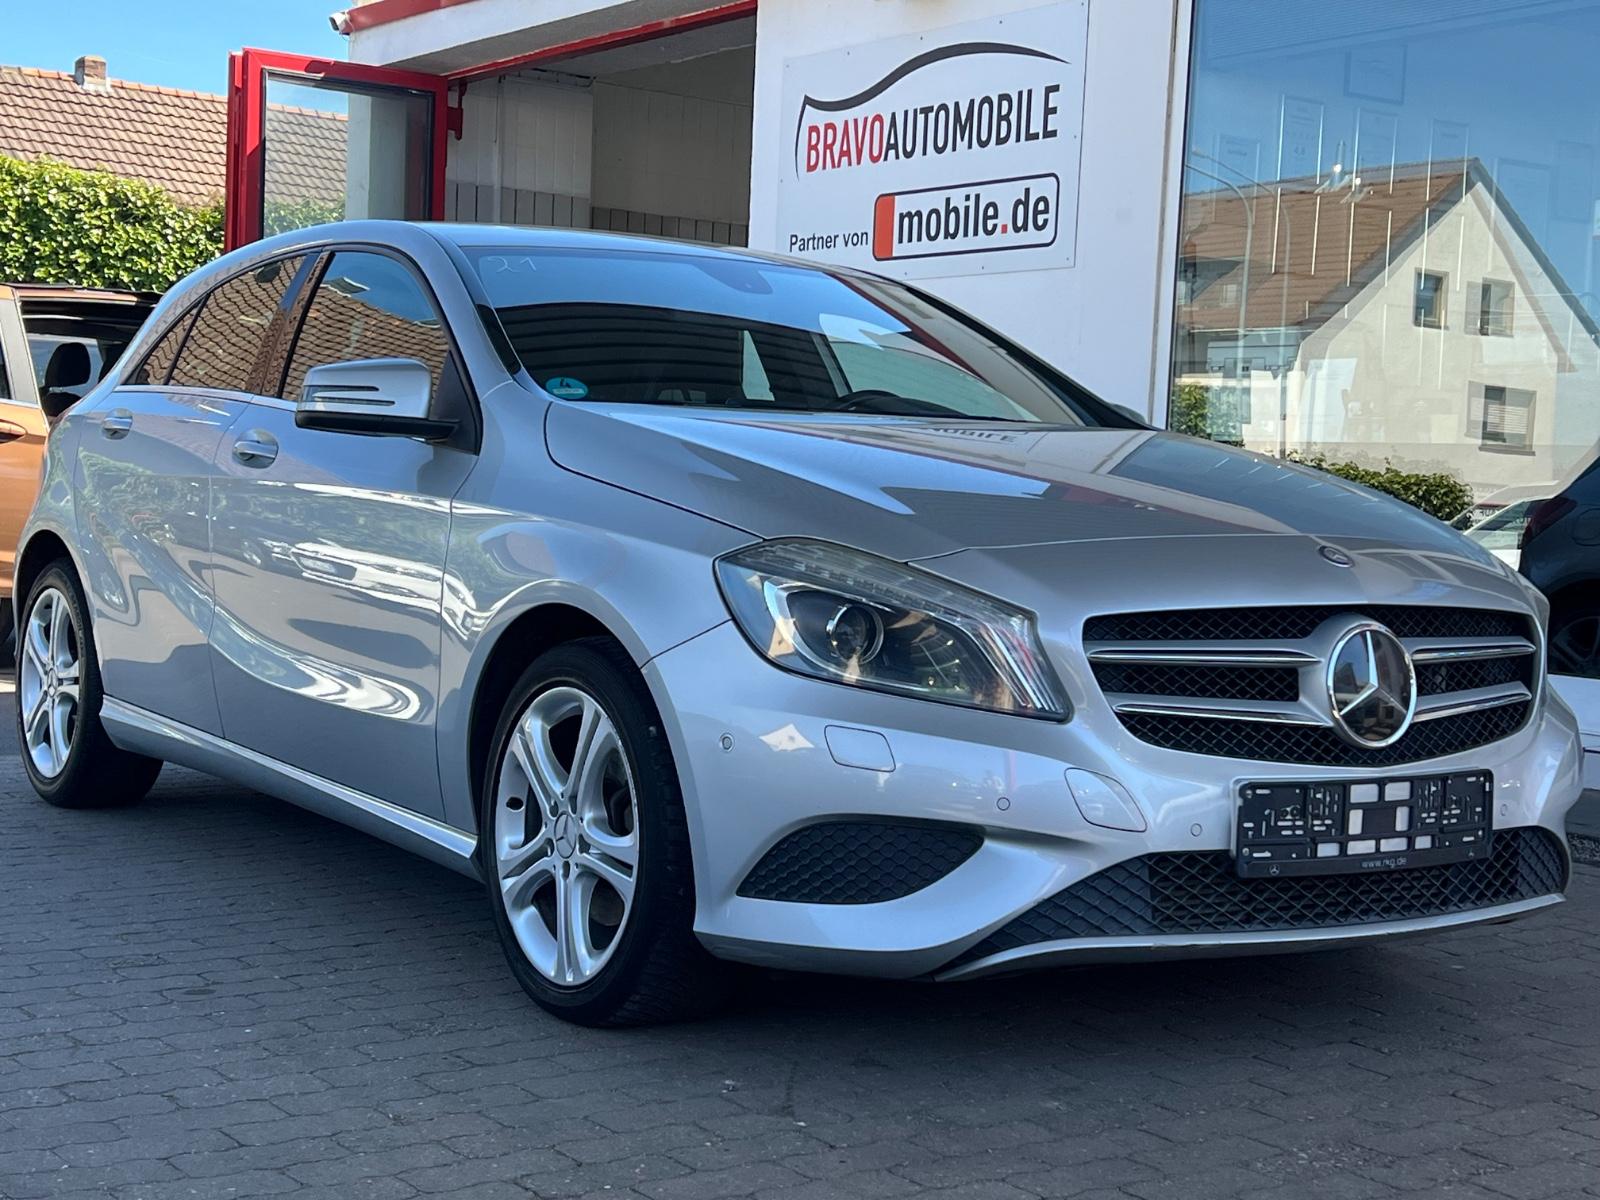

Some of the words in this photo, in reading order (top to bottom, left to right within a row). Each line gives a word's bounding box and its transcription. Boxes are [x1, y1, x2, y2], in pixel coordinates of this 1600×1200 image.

[806, 84, 1060, 173] BRAVOAUTOMOBILE
[789, 233, 839, 252] Partner
[843, 231, 868, 247] von
[898, 187, 1050, 244] mobile.de
